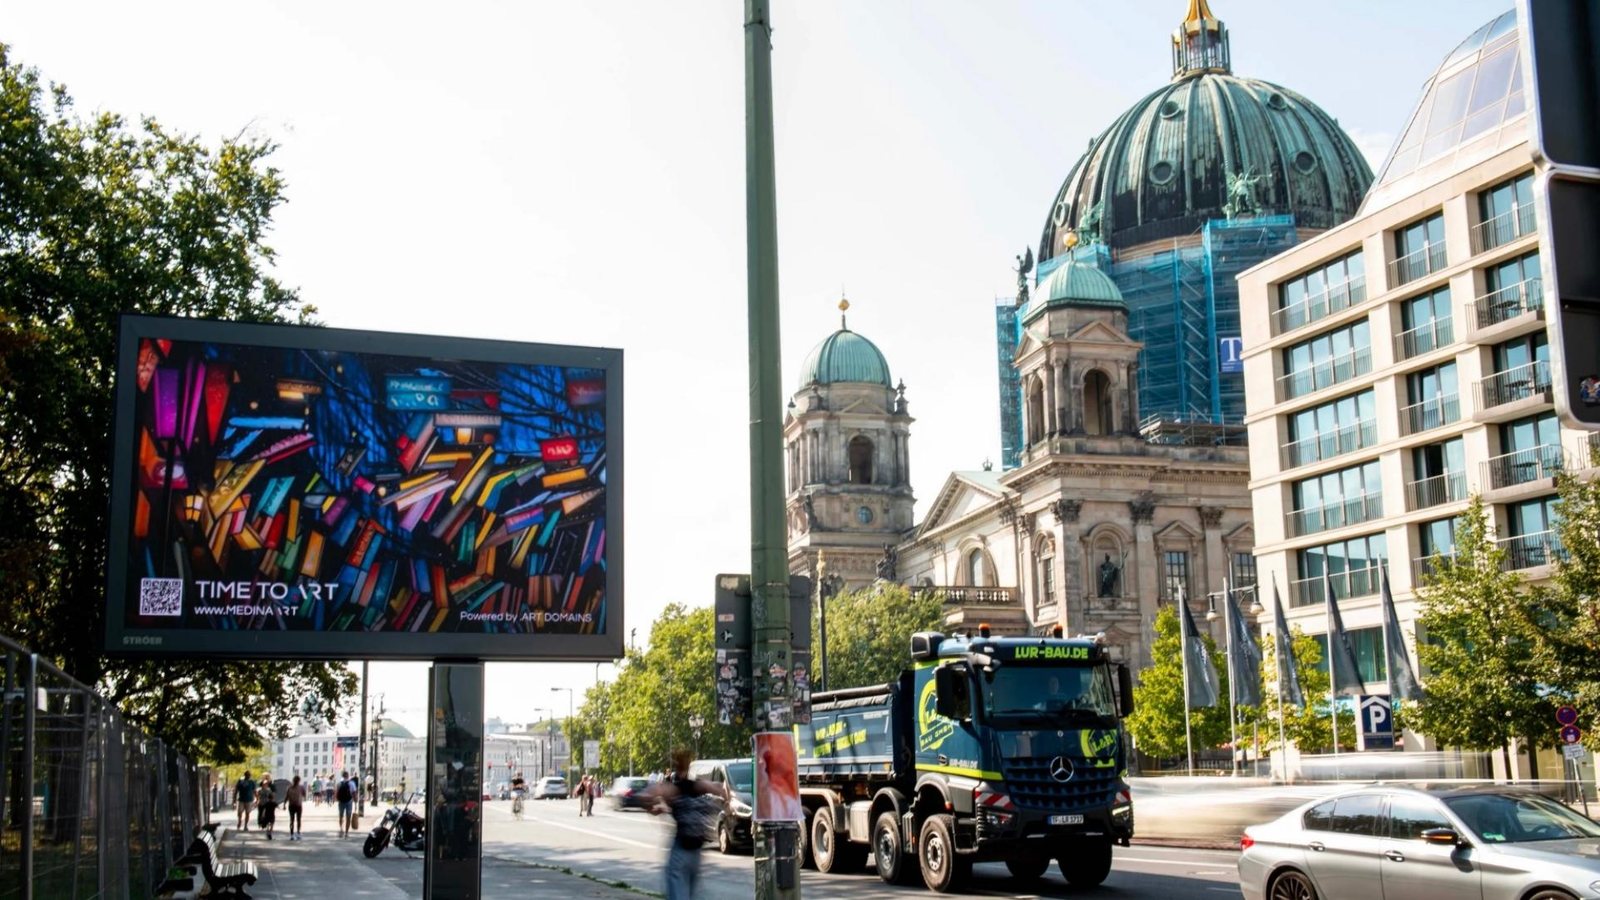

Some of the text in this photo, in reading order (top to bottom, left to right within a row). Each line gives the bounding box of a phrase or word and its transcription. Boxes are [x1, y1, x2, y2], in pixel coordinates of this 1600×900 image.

[195, 580, 251, 599] TIME
[256, 581, 288, 600] TO
[460, 610, 504, 621] Powered
[505, 611, 518, 624] by
[544, 612, 593, 623] DOMAINS
[1015, 646, 1089, 660] LUR-BAU.DE
[1369, 705, 1386, 733] P
